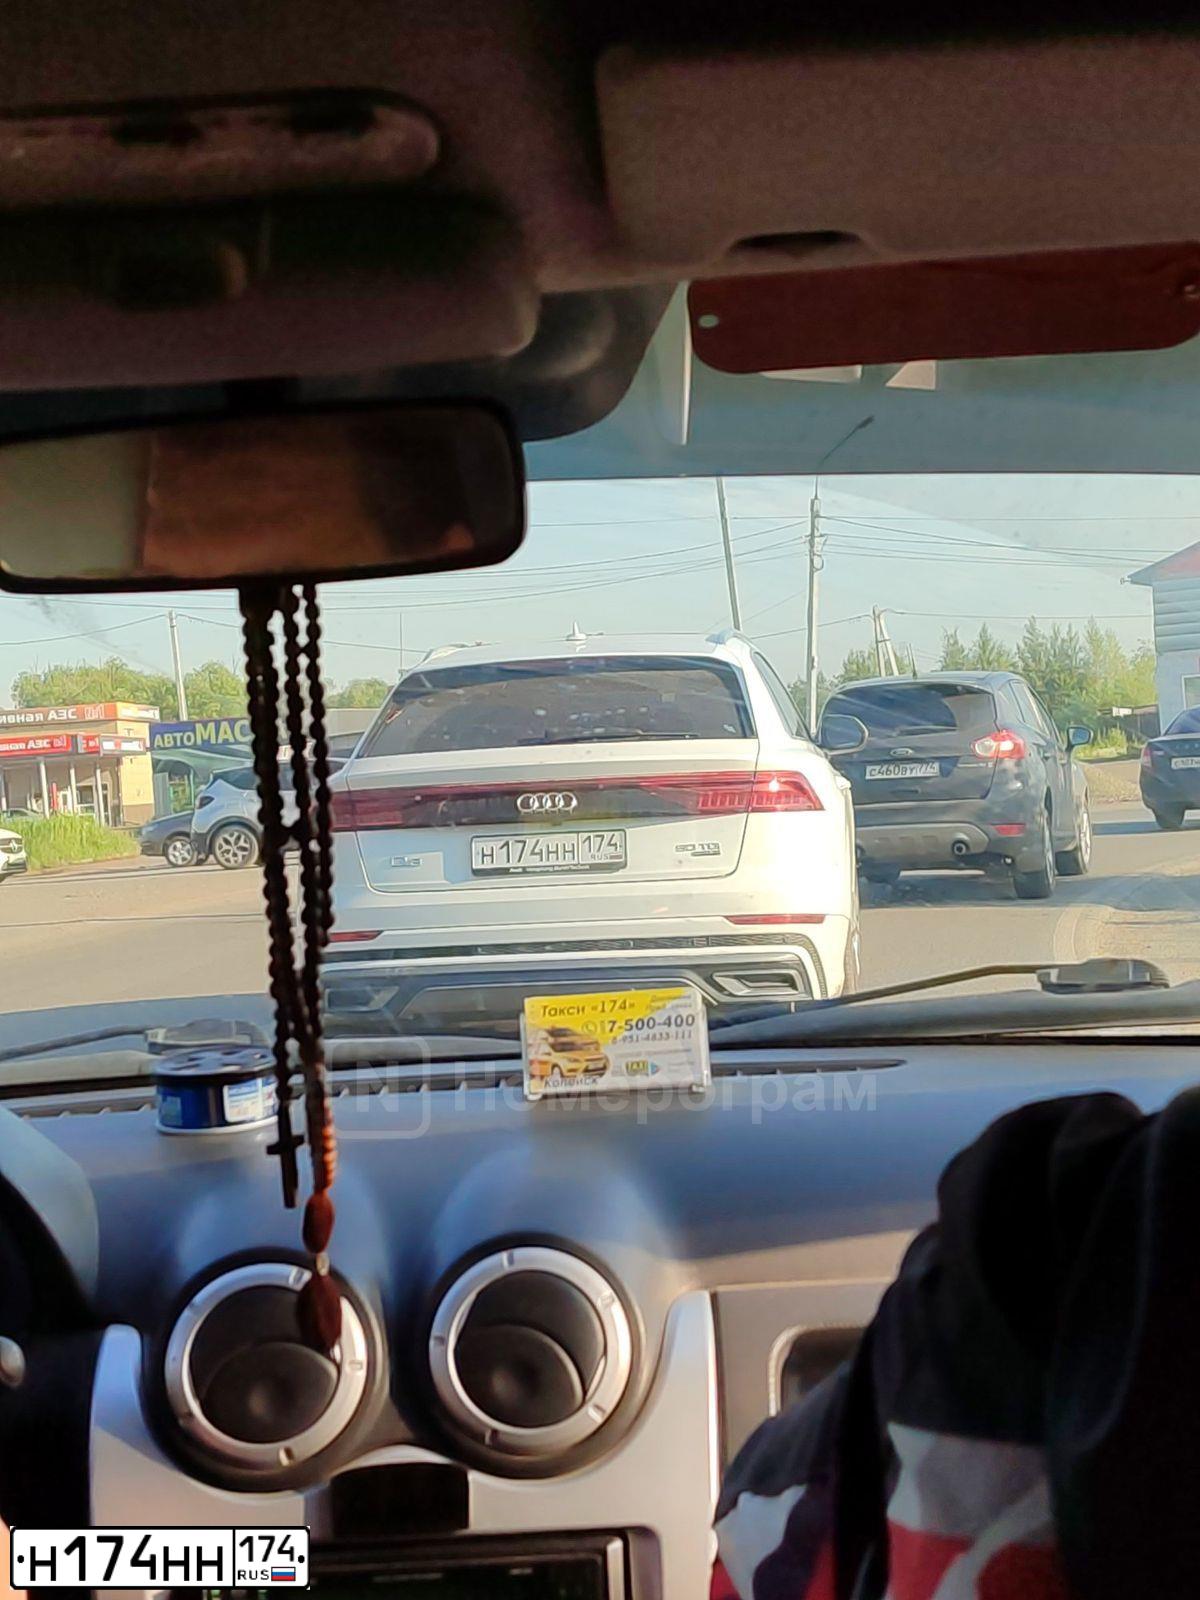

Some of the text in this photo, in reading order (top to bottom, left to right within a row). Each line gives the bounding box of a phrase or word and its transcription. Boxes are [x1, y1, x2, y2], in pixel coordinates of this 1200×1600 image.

[47, 708, 77, 720] АЗС
[481, 833, 620, 865] Н174НН 174
[541, 1005, 586, 1018] Такси
